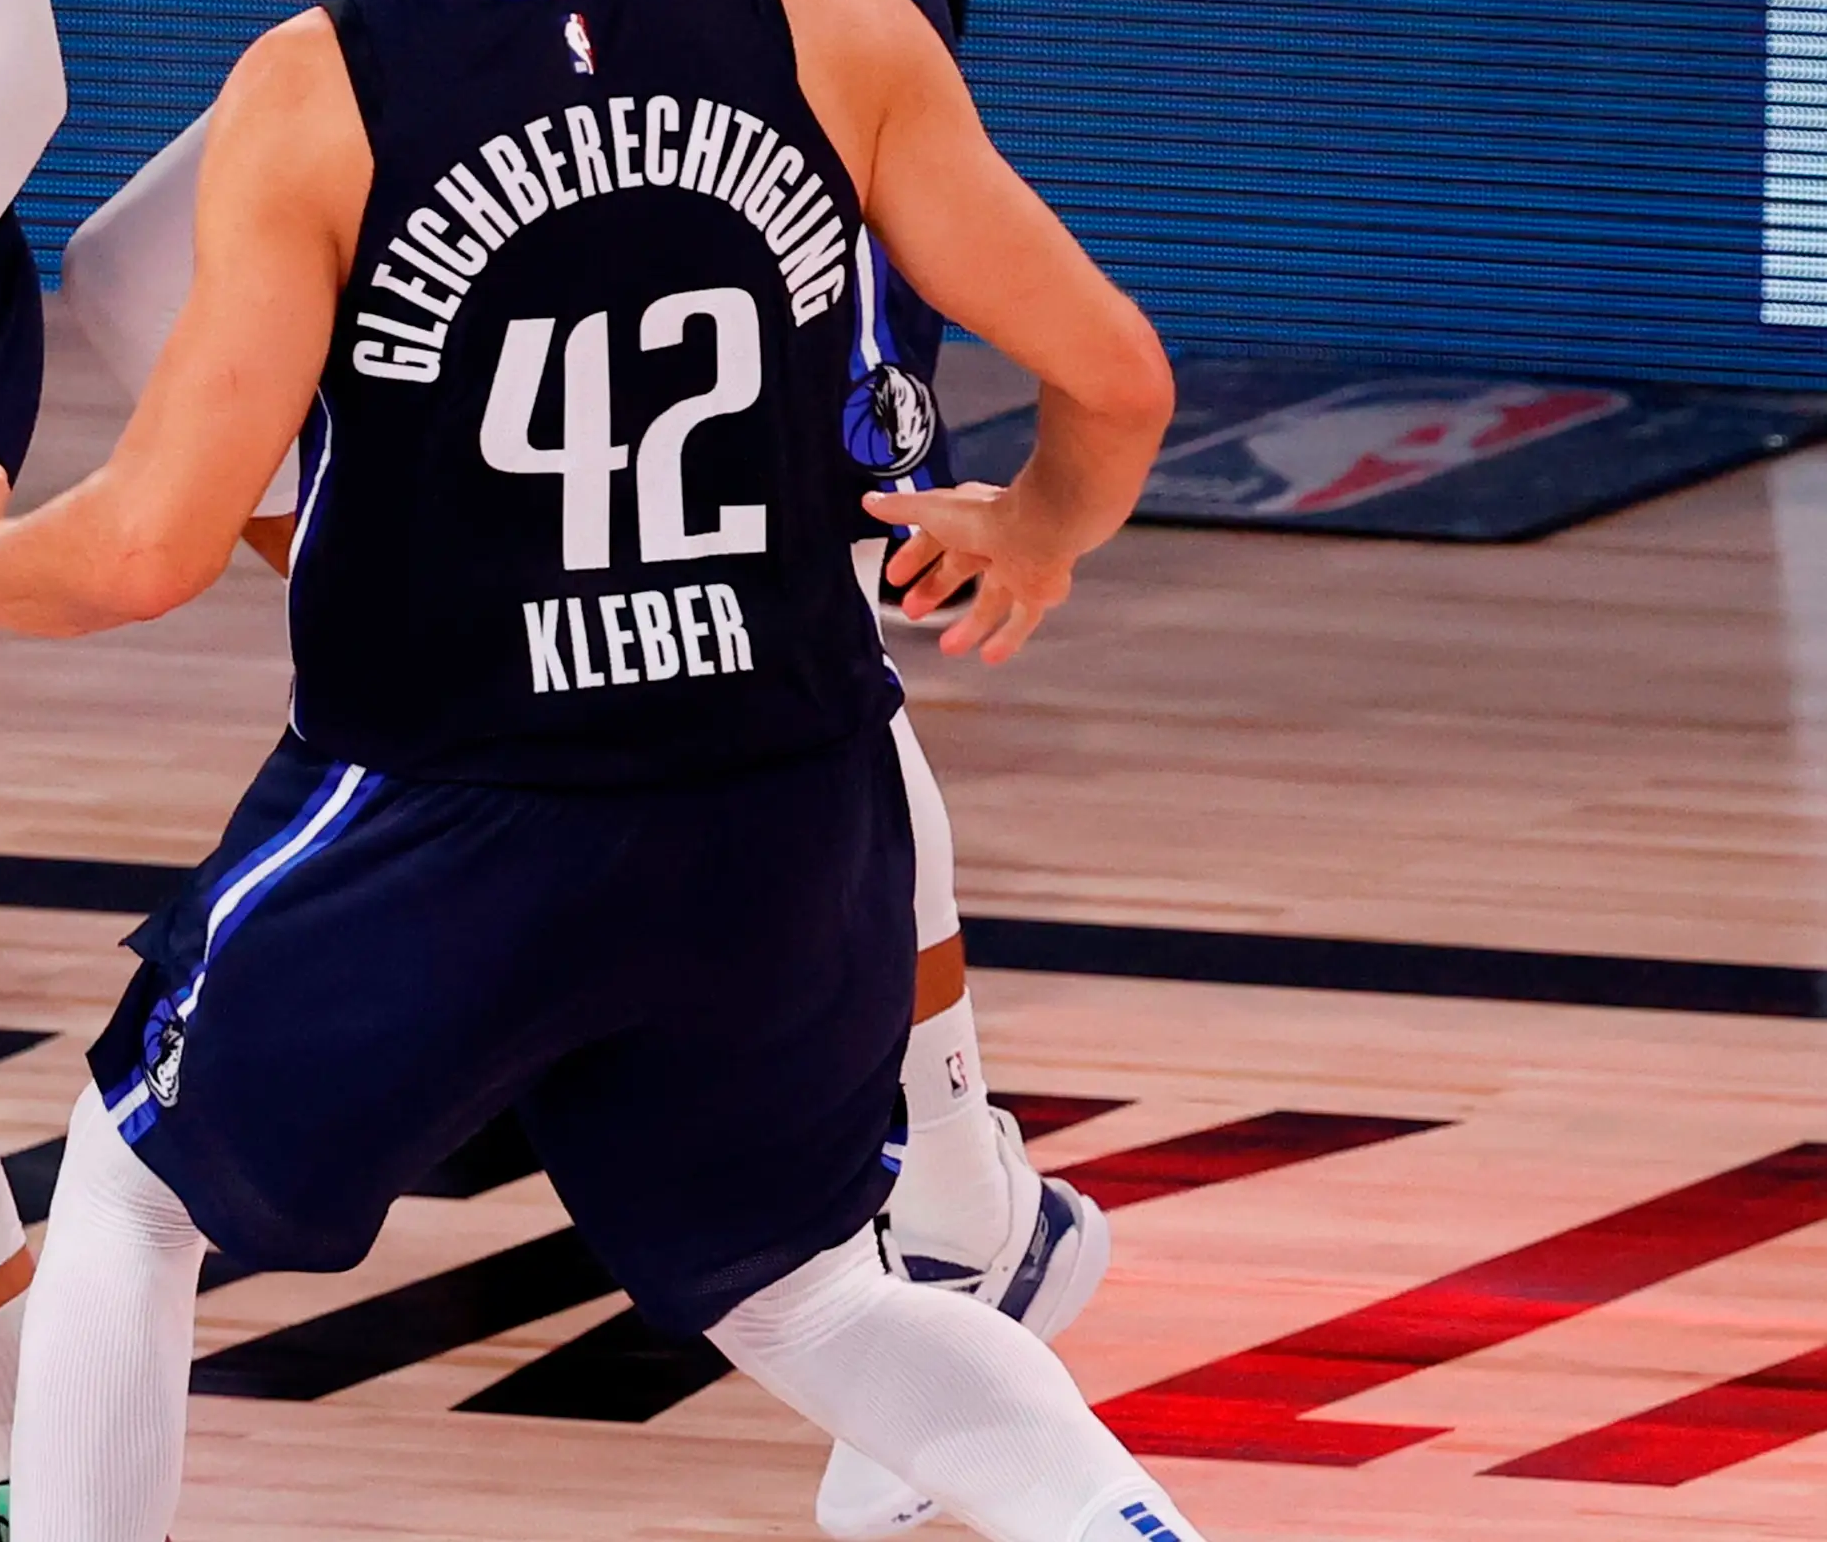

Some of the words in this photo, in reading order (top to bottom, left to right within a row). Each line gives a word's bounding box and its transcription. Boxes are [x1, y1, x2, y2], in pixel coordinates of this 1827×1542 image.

[353, 94, 848, 385] GLEICHBERECHTIGUNG
[479, 287, 767, 571] 42
[522, 583, 754, 694] KLEBER
